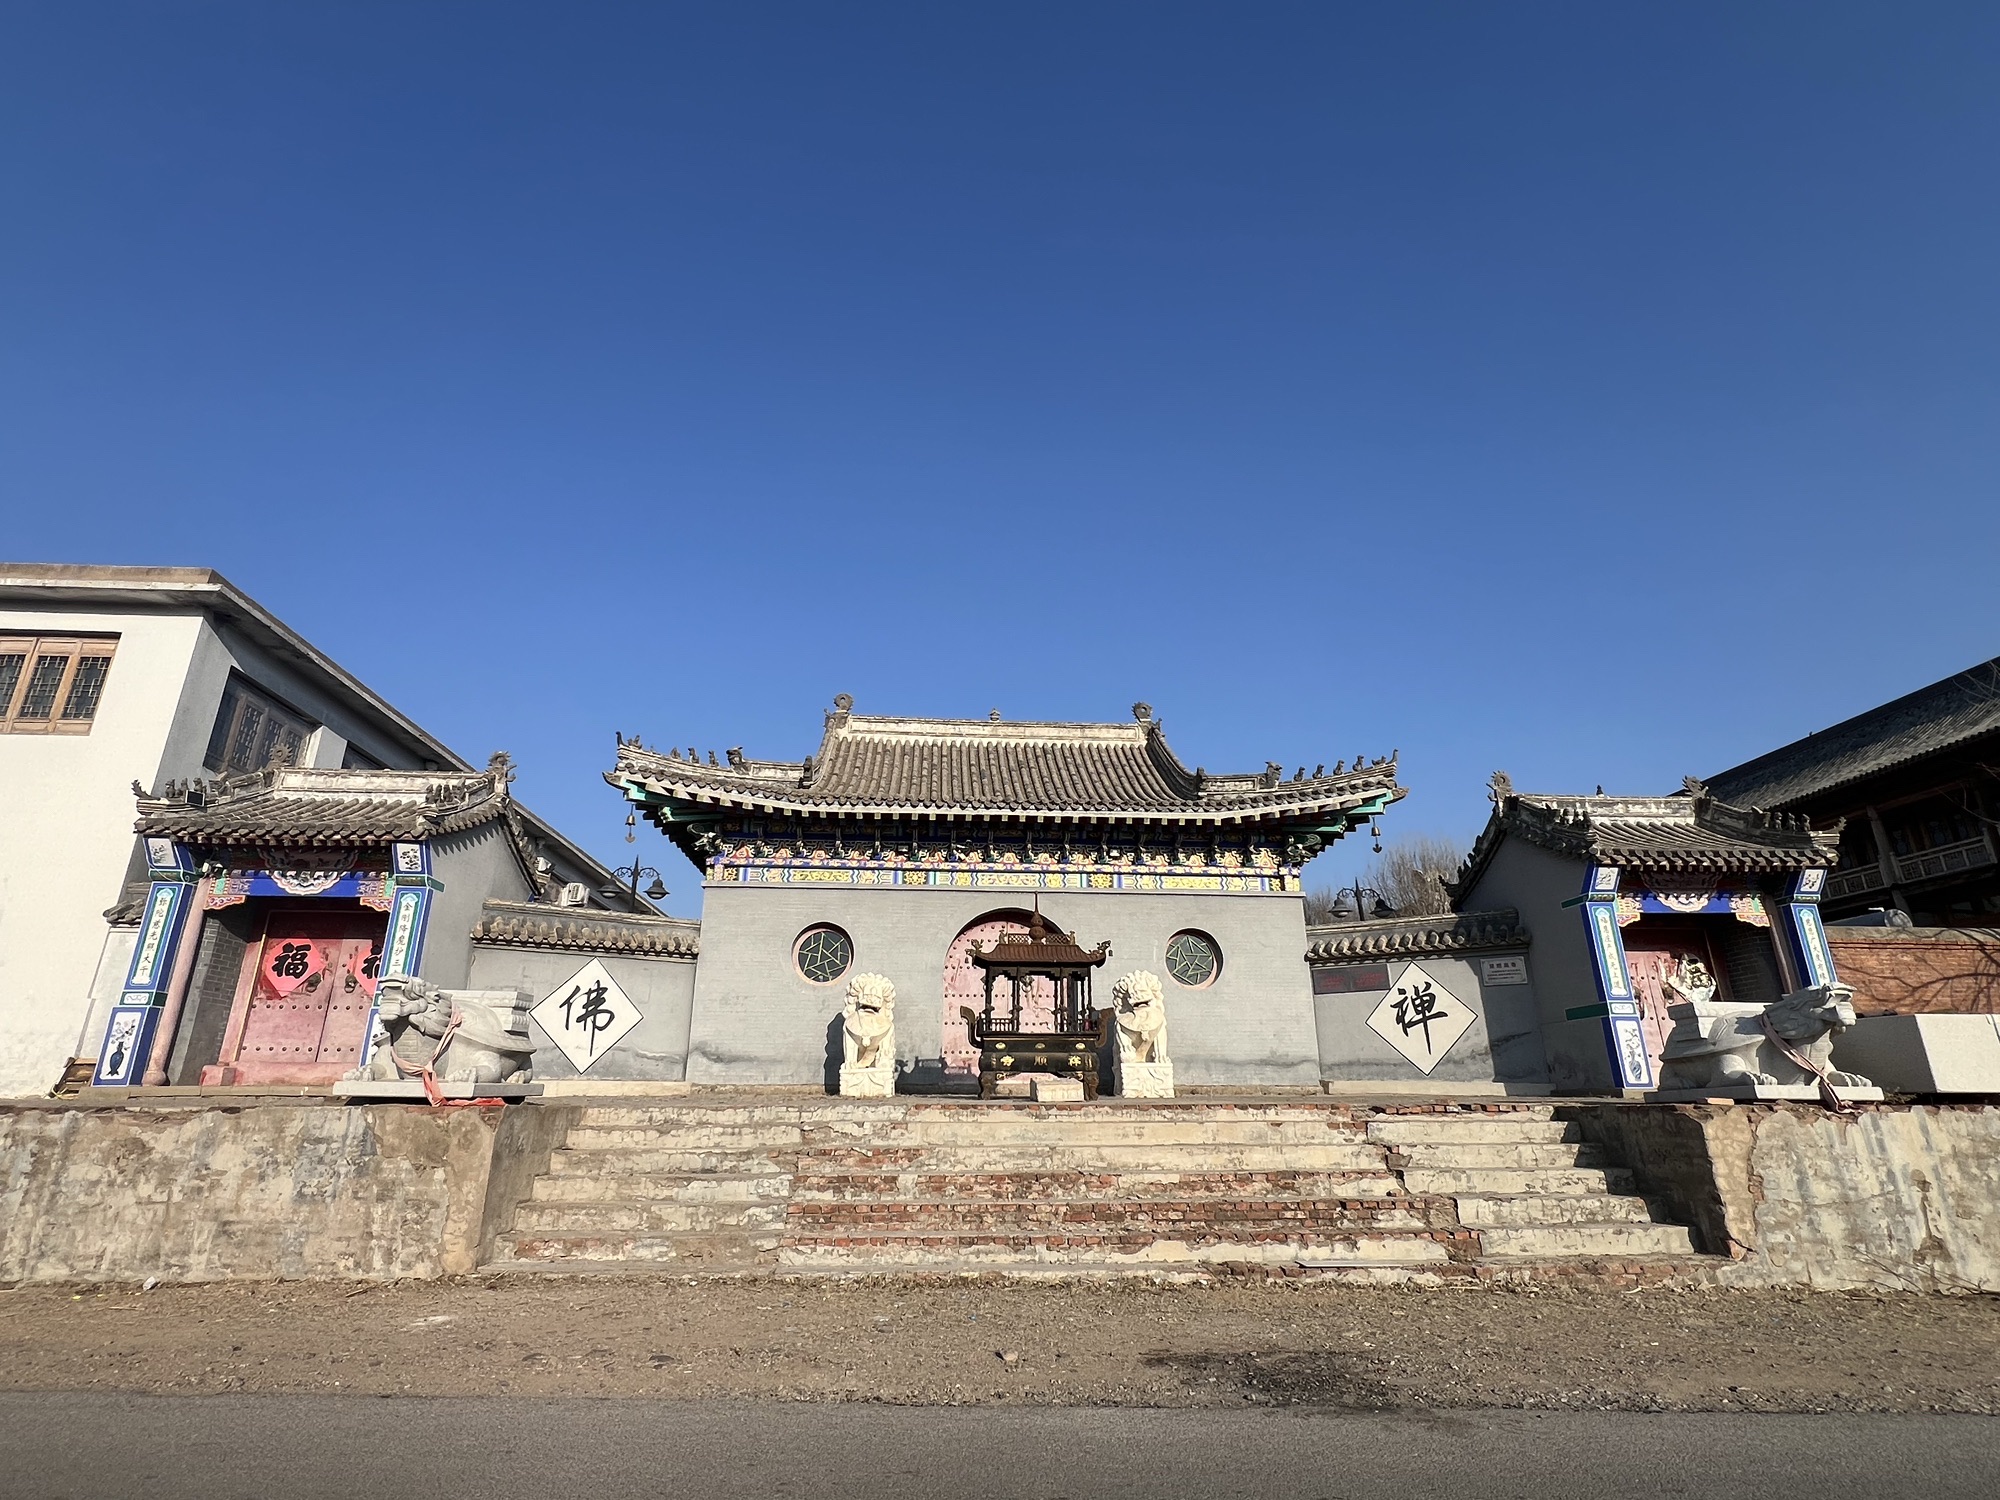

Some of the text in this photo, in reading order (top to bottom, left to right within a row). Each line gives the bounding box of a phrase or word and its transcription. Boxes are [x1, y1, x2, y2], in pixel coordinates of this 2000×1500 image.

[272, 943, 312, 979] 福
[391, 902, 413, 973] 金刚降魔护三
[559, 979, 615, 1057] 佛
